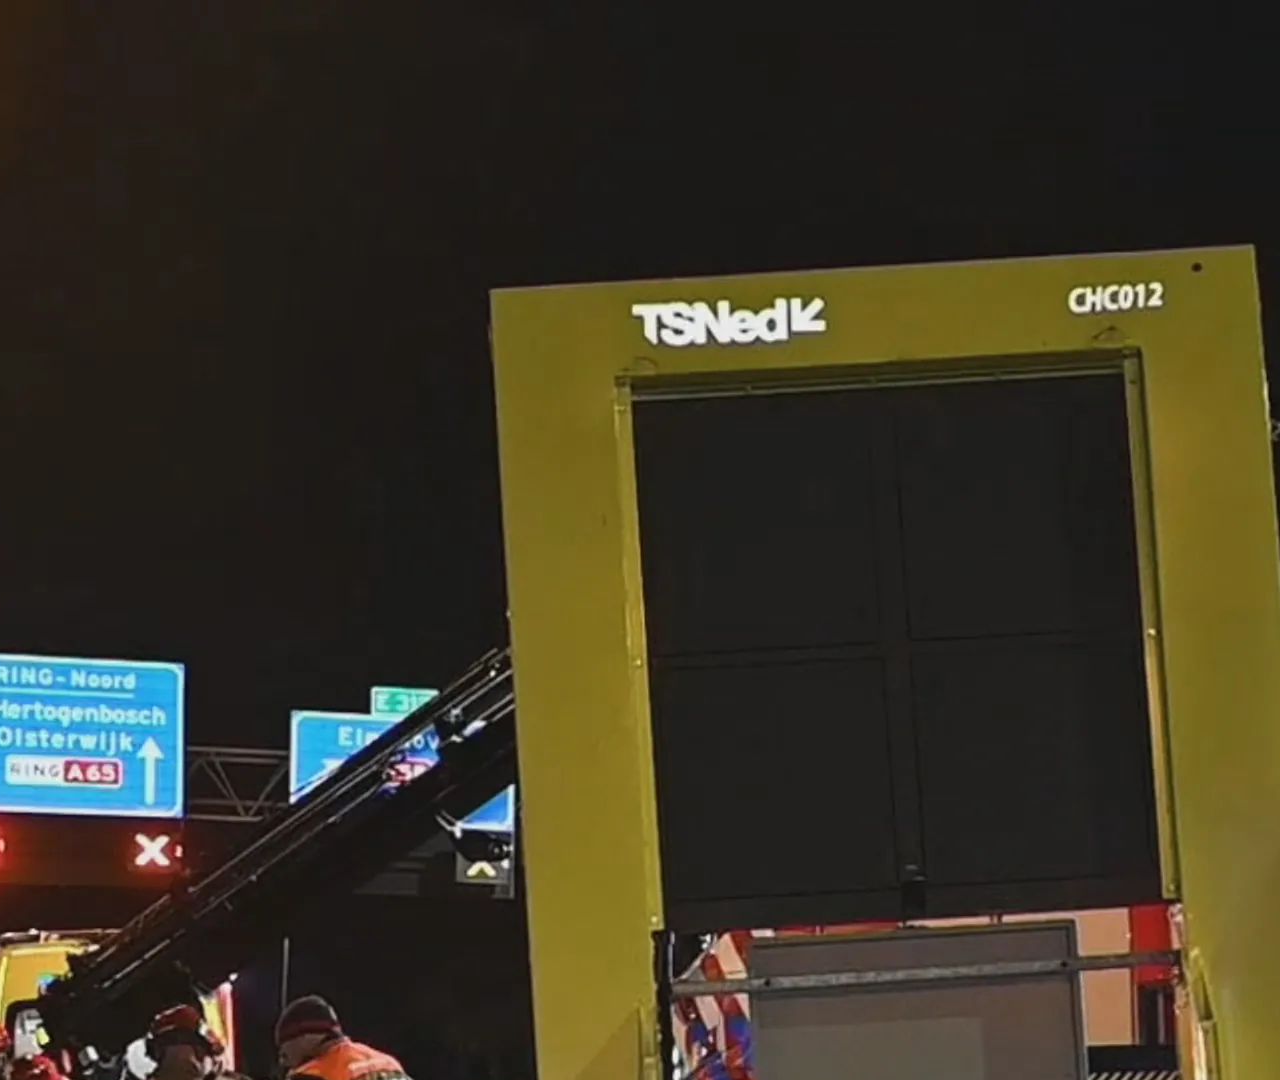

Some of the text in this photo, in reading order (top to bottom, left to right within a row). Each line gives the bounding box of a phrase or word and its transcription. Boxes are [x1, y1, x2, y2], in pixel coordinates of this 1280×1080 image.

[1068, 282, 1163, 314] CHC012
[631, 297, 789, 346] TSNed
[10, 762, 116, 782] RING A65
